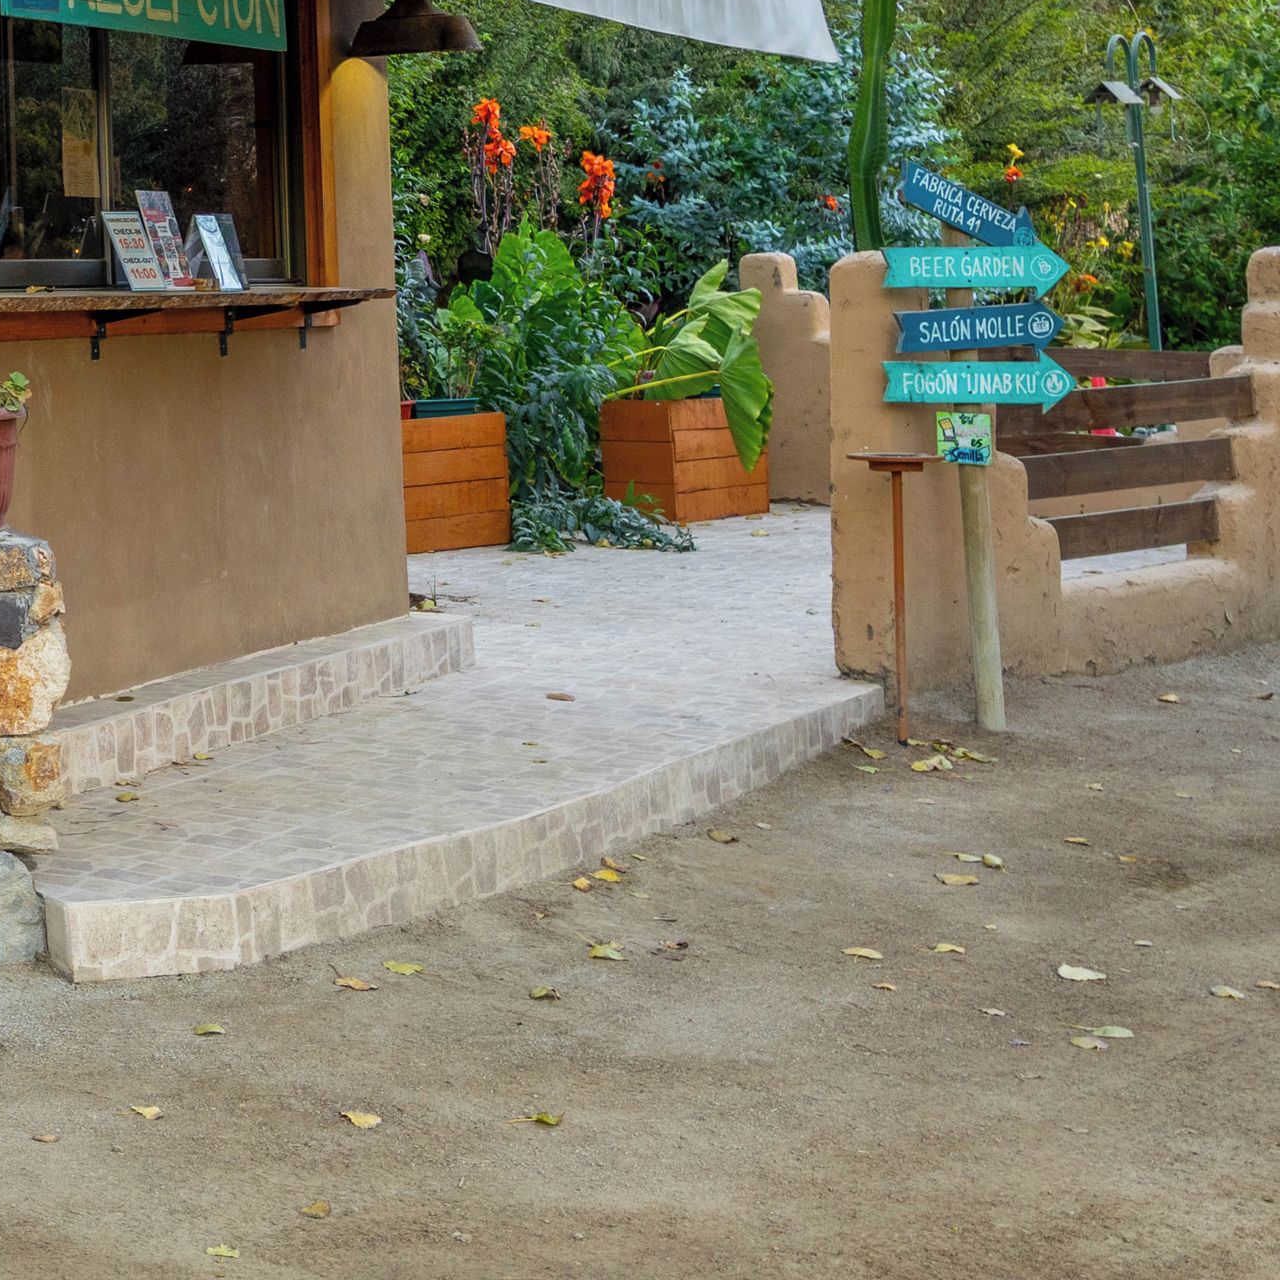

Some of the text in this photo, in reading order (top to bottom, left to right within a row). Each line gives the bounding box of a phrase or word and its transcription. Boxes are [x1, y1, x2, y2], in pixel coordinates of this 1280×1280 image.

[933, 198, 981, 234] RUTA 41
[966, 195, 1017, 233] CERVEZA
[113, 228, 142, 236] CHECK-IN
[118, 237, 145, 250] 15:30
[131, 267, 157, 279] 11:00
[909, 255, 1025, 278] BEER GARDEN
[919, 315, 1025, 344] SALÓN MOLLE
[902, 369, 958, 395] FOGÓN
